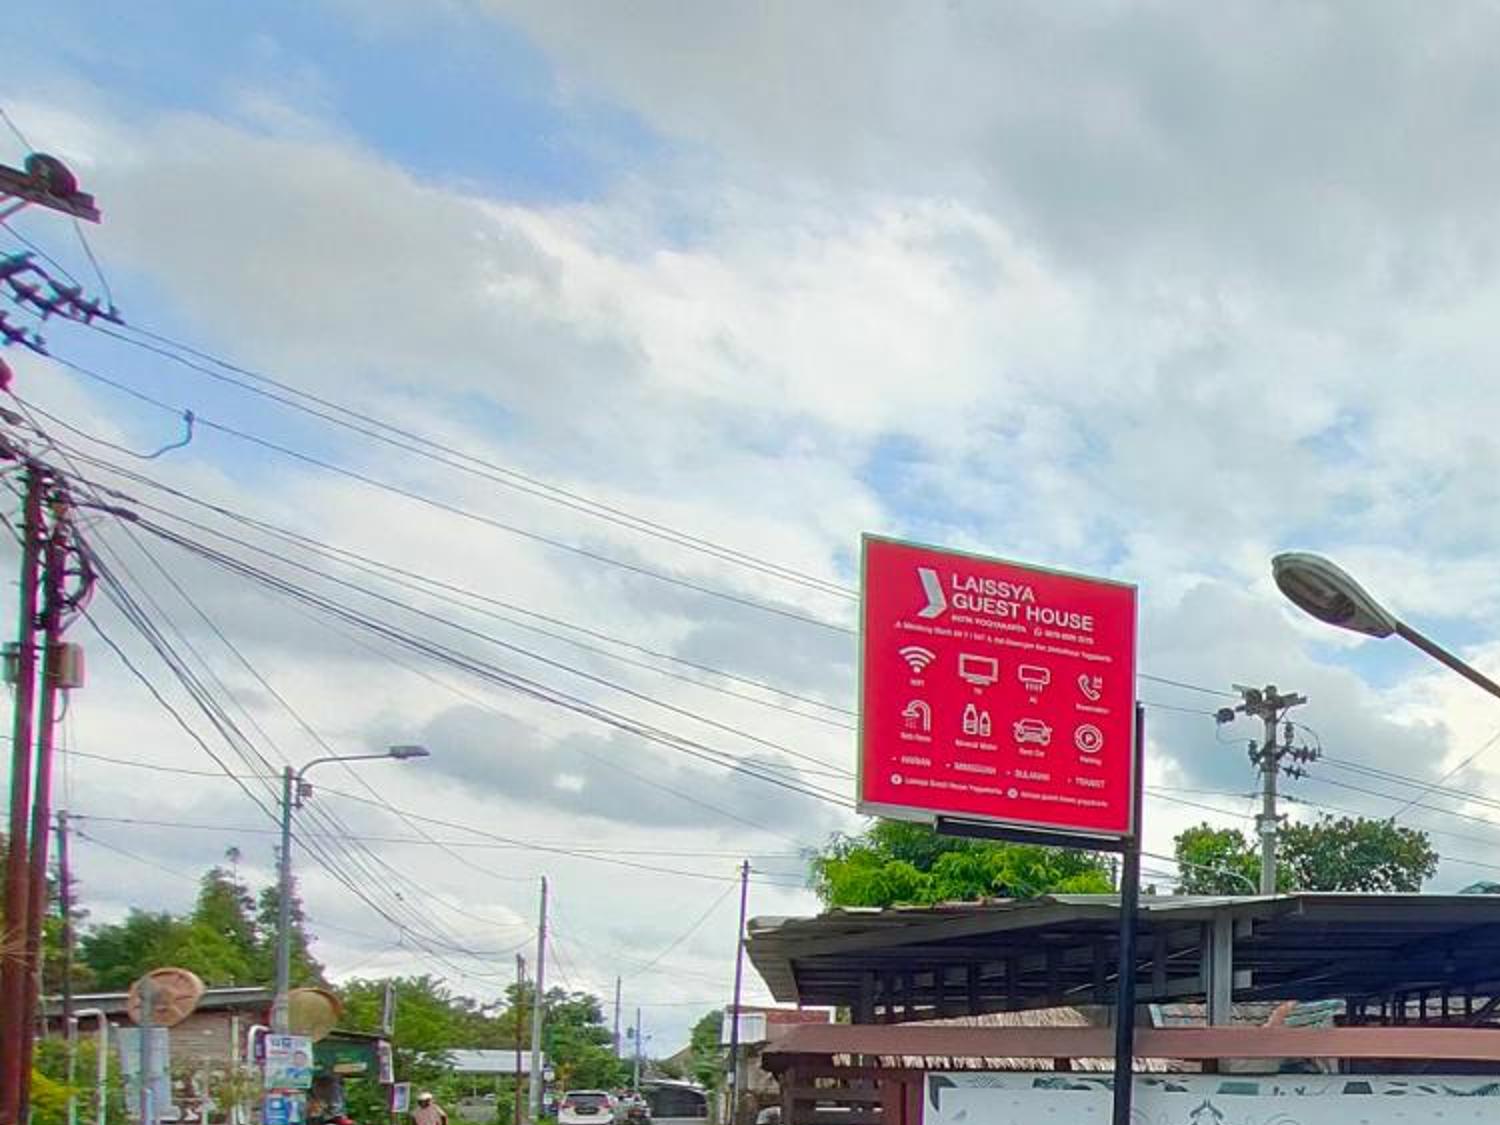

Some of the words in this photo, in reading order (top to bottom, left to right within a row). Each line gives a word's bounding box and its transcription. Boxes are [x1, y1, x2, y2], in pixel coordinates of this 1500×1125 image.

[952, 573, 1035, 602] LAISSYA
[952, 592, 1021, 618] GUEST
[1025, 605, 1094, 632] HOUSE
